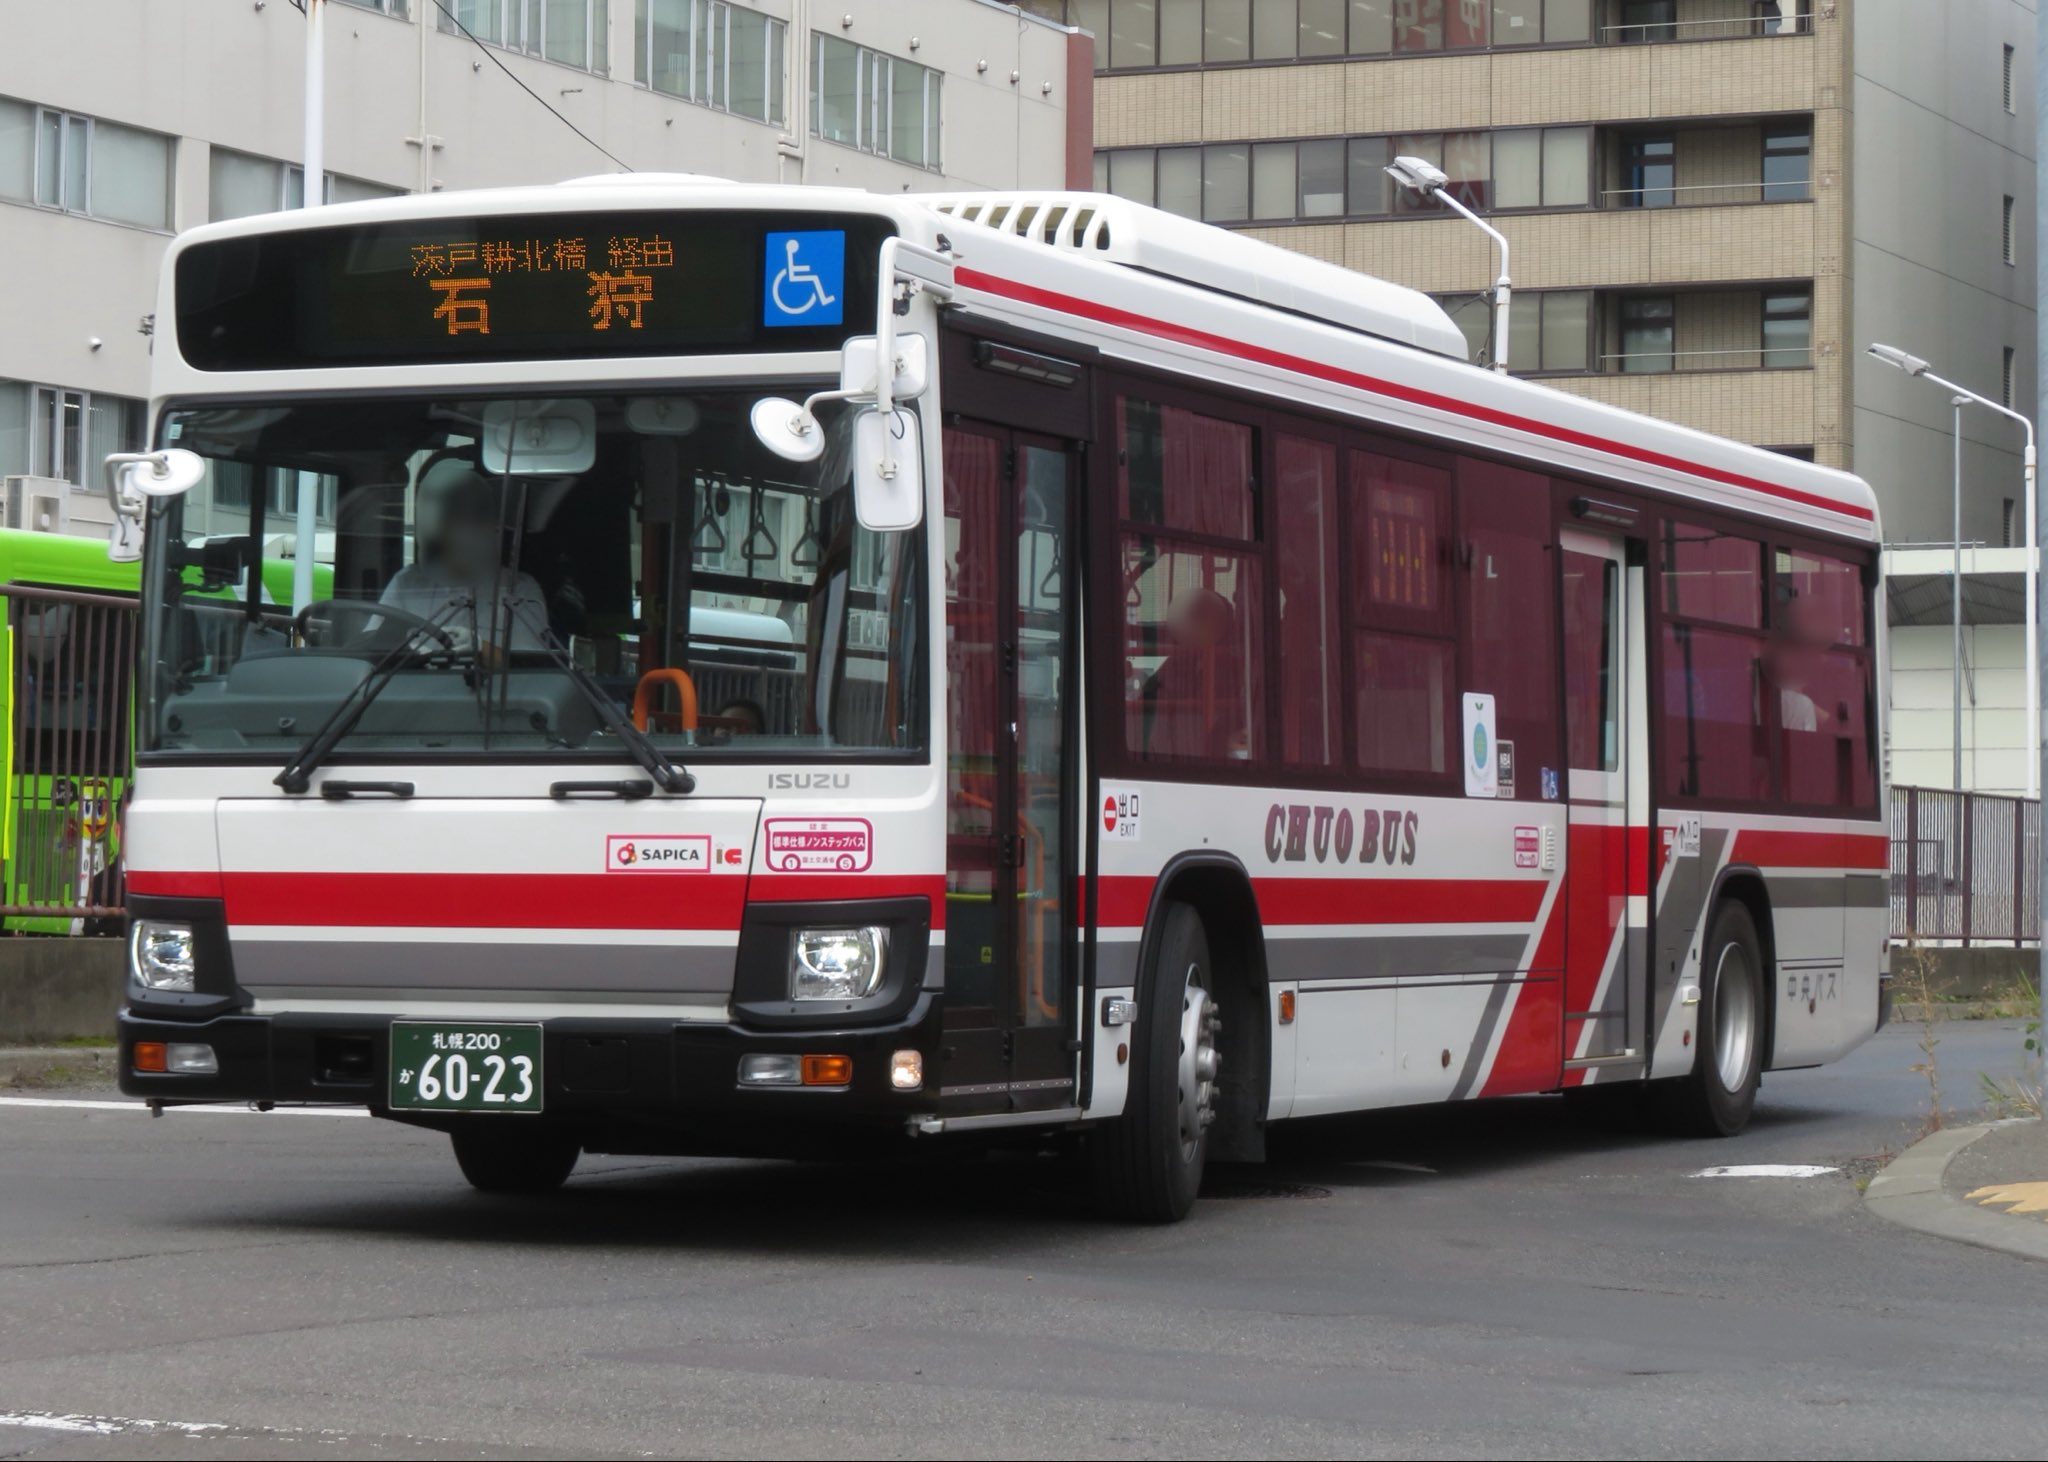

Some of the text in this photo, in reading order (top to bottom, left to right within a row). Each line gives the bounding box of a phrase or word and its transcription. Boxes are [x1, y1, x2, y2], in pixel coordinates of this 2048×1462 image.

[410, 234, 674, 277] 茨戸耕北橋 経由
[768, 773, 850, 790] ISUZU
[1118, 793, 1139, 818] 出口
[1120, 823, 1136, 837] EXIT
[1264, 803, 1419, 866] CHUO BUS
[773, 835, 865, 848] 標準仕様ノンステップバス
[641, 848, 700, 861] SAPICA
[1787, 972, 1837, 1001] 中央バス
[432, 1033, 501, 1050] 札幌200
[399, 1054, 533, 1103] か 60-23
